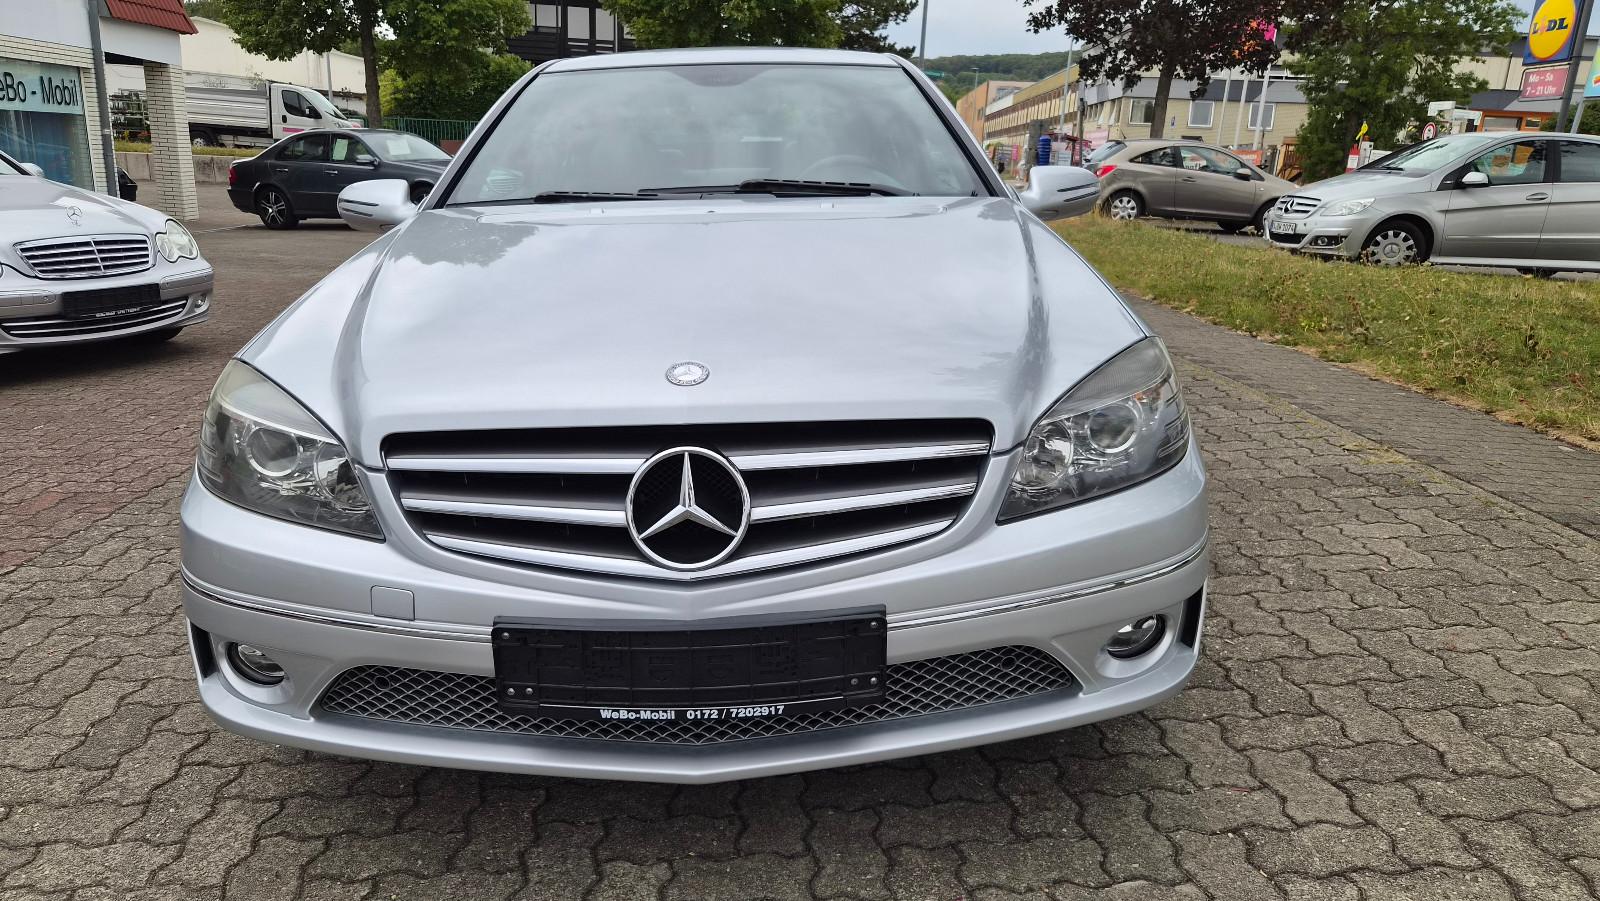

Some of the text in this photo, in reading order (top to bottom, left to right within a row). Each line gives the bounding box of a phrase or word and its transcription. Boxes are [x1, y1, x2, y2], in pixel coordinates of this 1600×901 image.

[1529, 73, 1539, 83] Mo
[1545, 73, 1553, 82] Sa
[40, 75, 78, 106] Mobil
[1544, 85, 1556, 95] Uhr
[600, 708, 676, 721] WeBo-Mobil
[686, 708, 719, 720] 0172
[729, 705, 785, 719] 7202917
